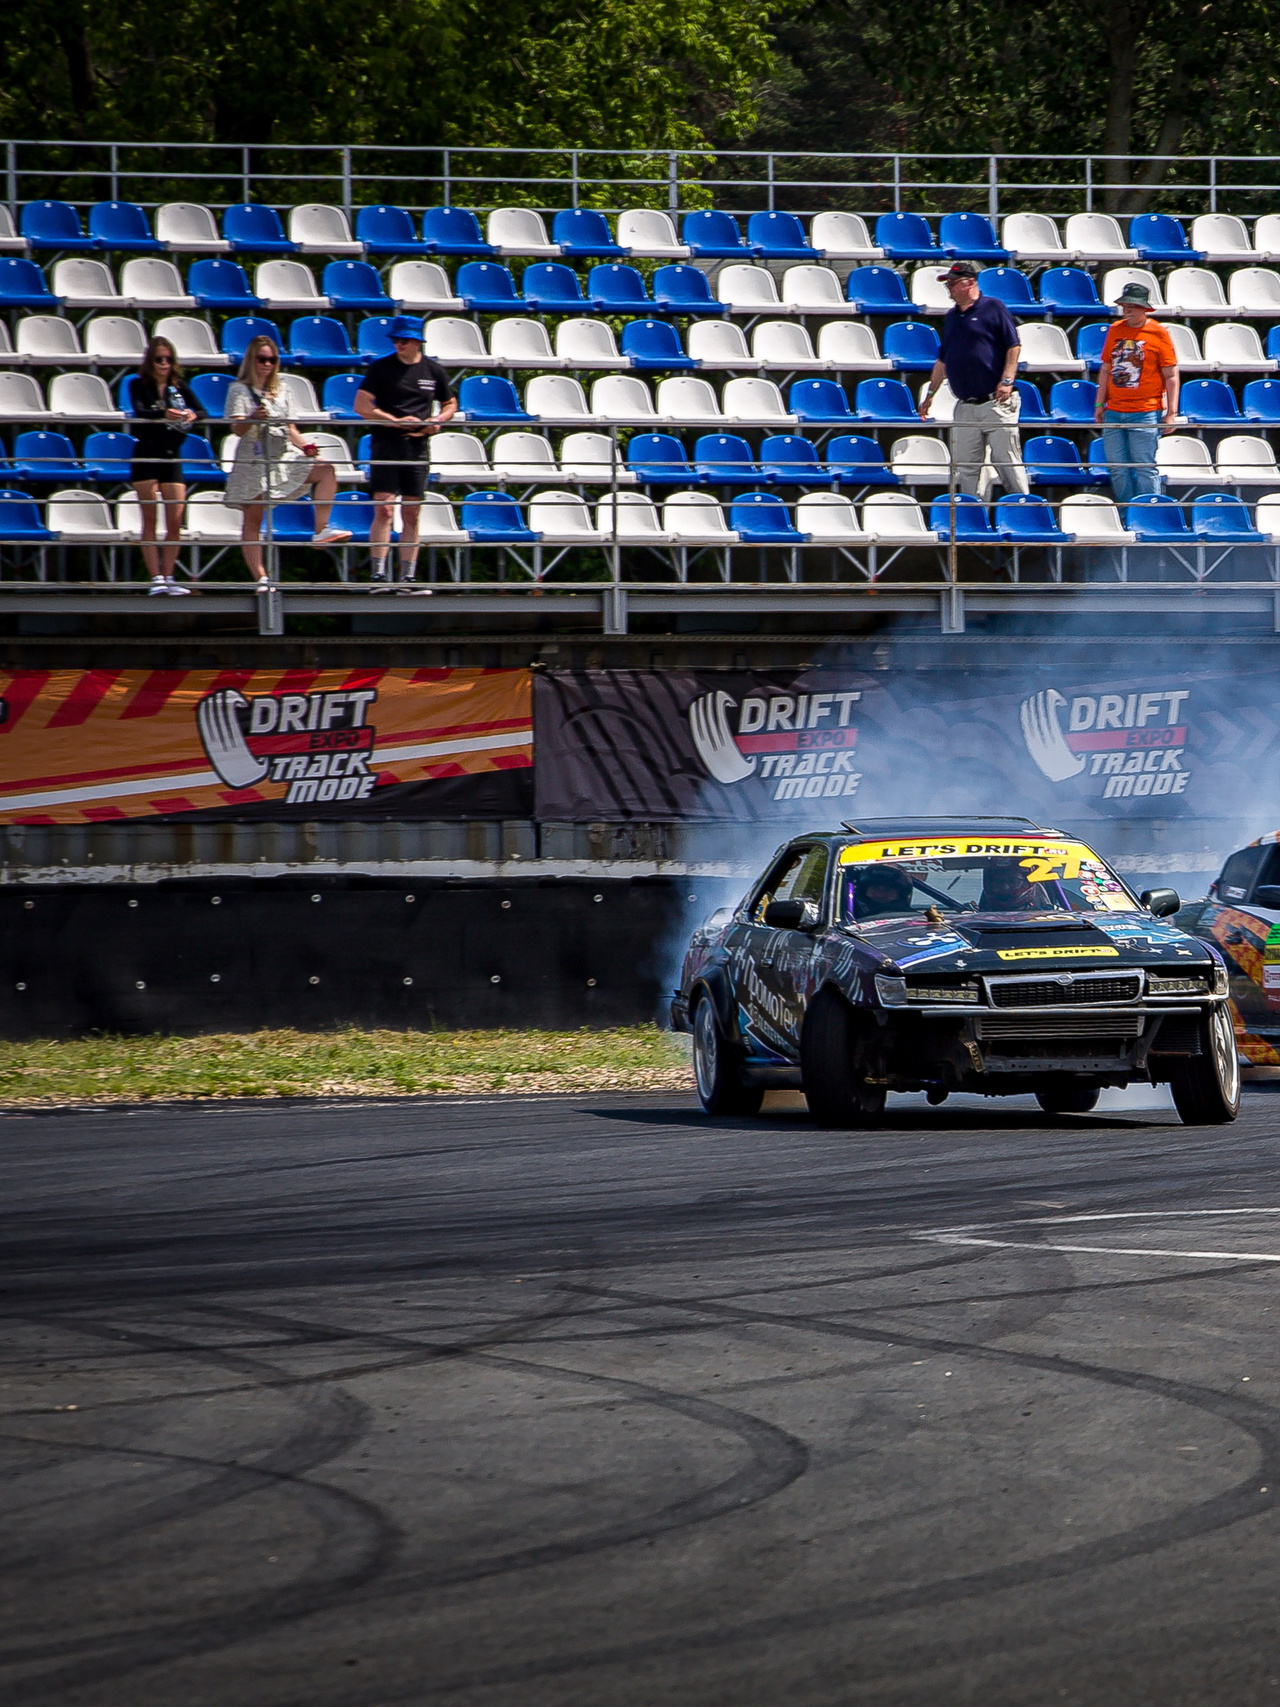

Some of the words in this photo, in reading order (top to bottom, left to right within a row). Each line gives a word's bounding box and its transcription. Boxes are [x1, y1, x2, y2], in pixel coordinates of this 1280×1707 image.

[249, 690, 376, 733] DRIFT
[738, 691, 862, 733] DRIFT
[1069, 690, 1191, 732] DRIFT
[310, 732, 359, 749] EXPO
[797, 732, 846, 747] EXPO
[1126, 730, 1175, 746] EXPO
[881, 845, 956, 857] LET'S
[1018, 858, 1081, 883] 27
